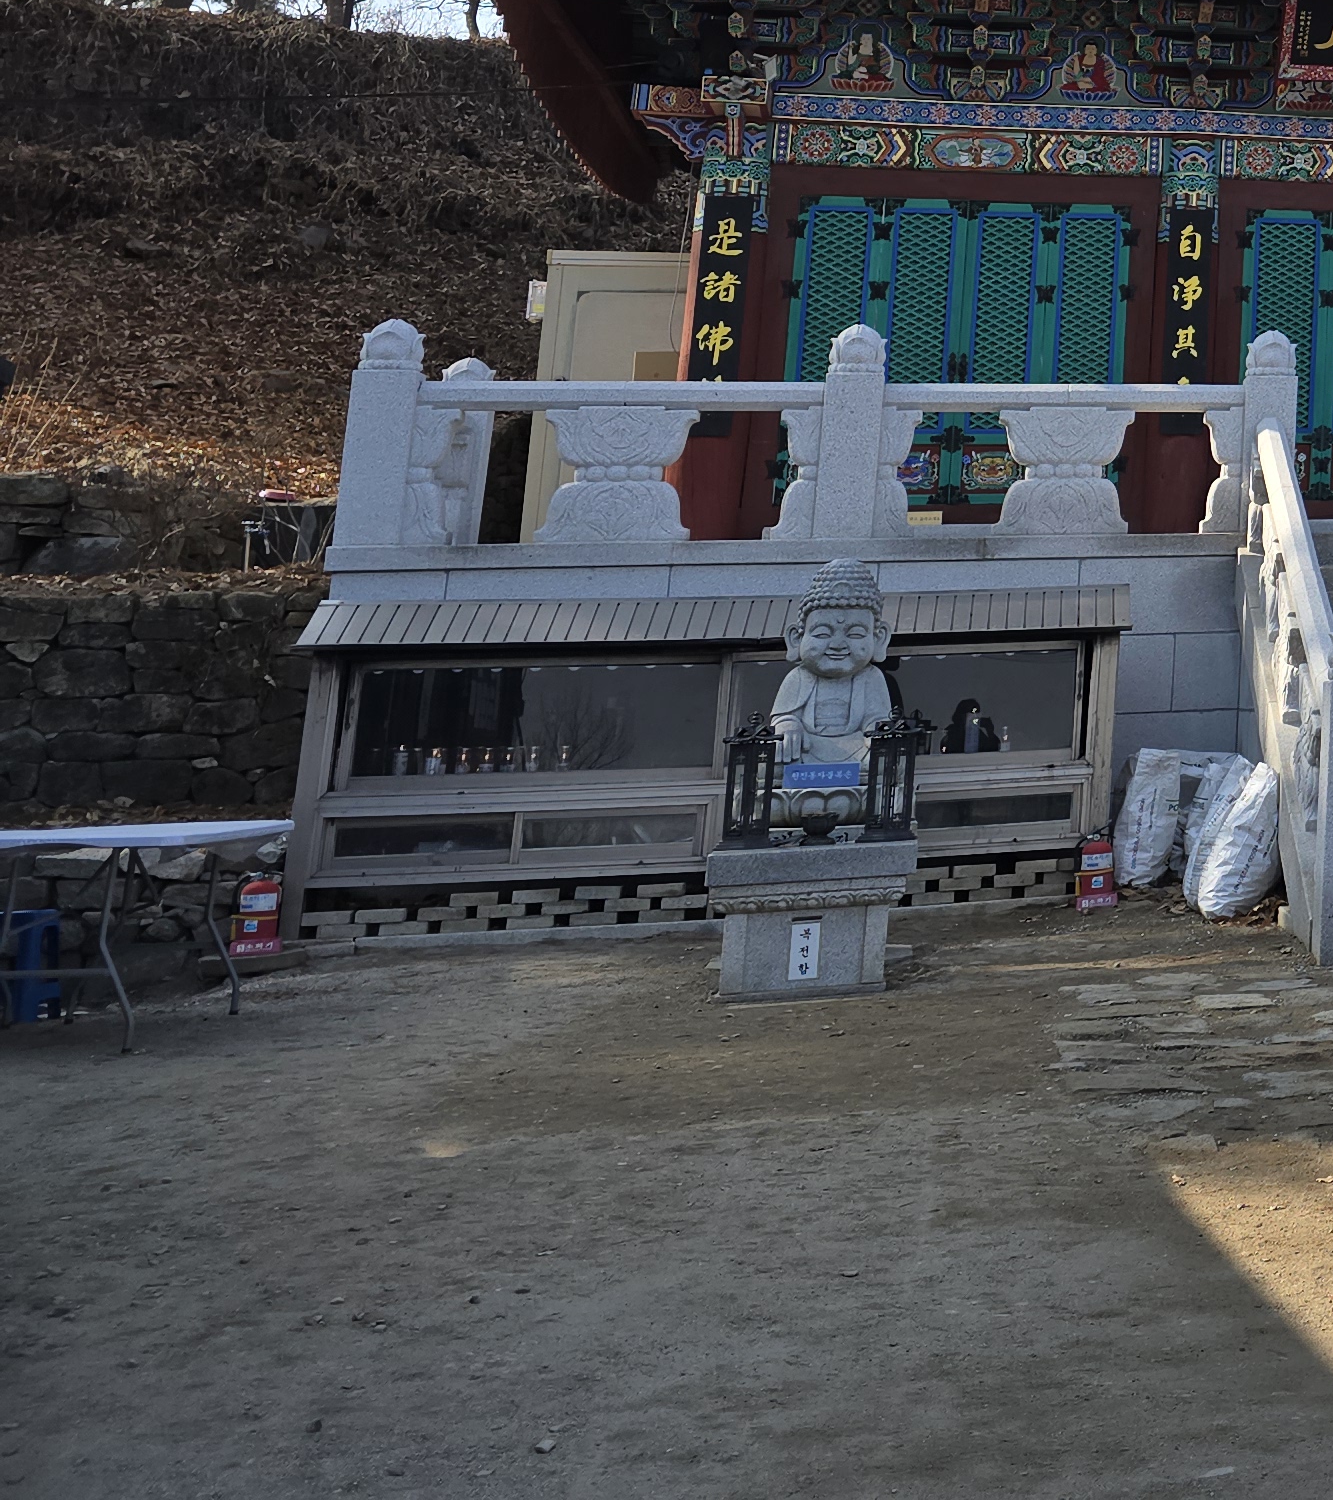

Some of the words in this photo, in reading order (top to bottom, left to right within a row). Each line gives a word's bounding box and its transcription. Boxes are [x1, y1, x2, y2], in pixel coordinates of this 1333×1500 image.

[695, 216, 744, 382] 是諸佛
[1172, 224, 1203, 385] 自淨其
[798, 928, 812, 975] 복전함
